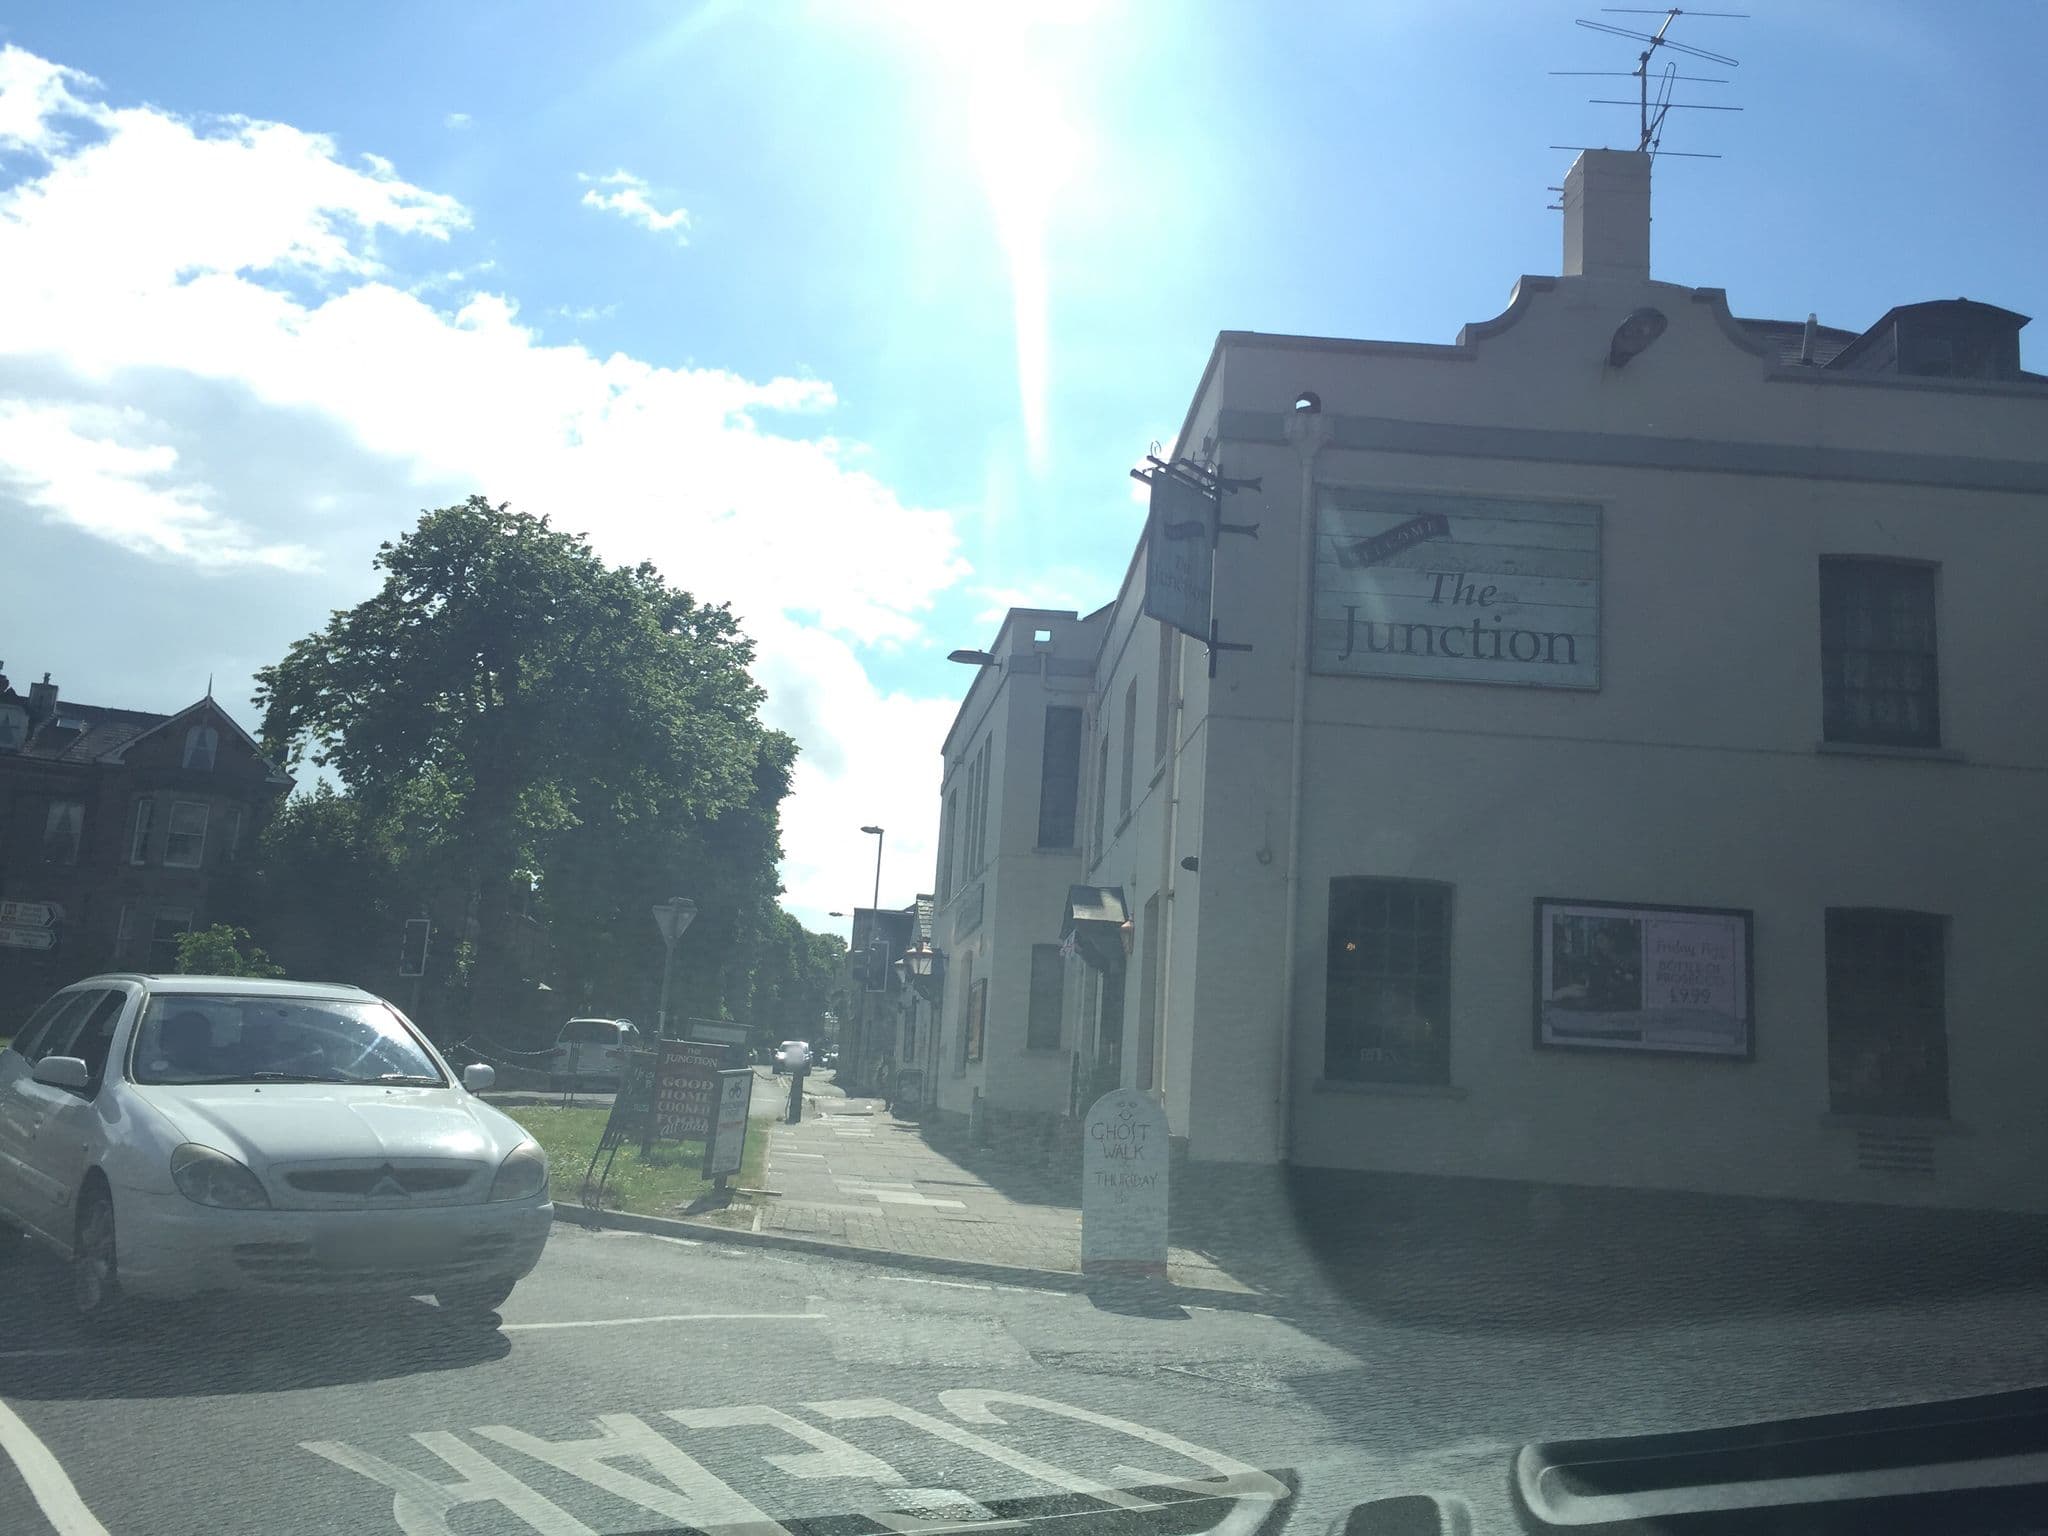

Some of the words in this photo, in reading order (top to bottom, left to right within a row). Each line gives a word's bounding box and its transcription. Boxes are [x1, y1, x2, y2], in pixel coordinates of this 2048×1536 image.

[1425, 569, 1499, 608] The
[1337, 604, 1578, 666] Junction
[665, 1053, 719, 1068] JUNCTION
[661, 1076, 715, 1090] GOOD
[1091, 1121, 1151, 1144] GHOST
[1102, 1145, 1146, 1161] WALK
